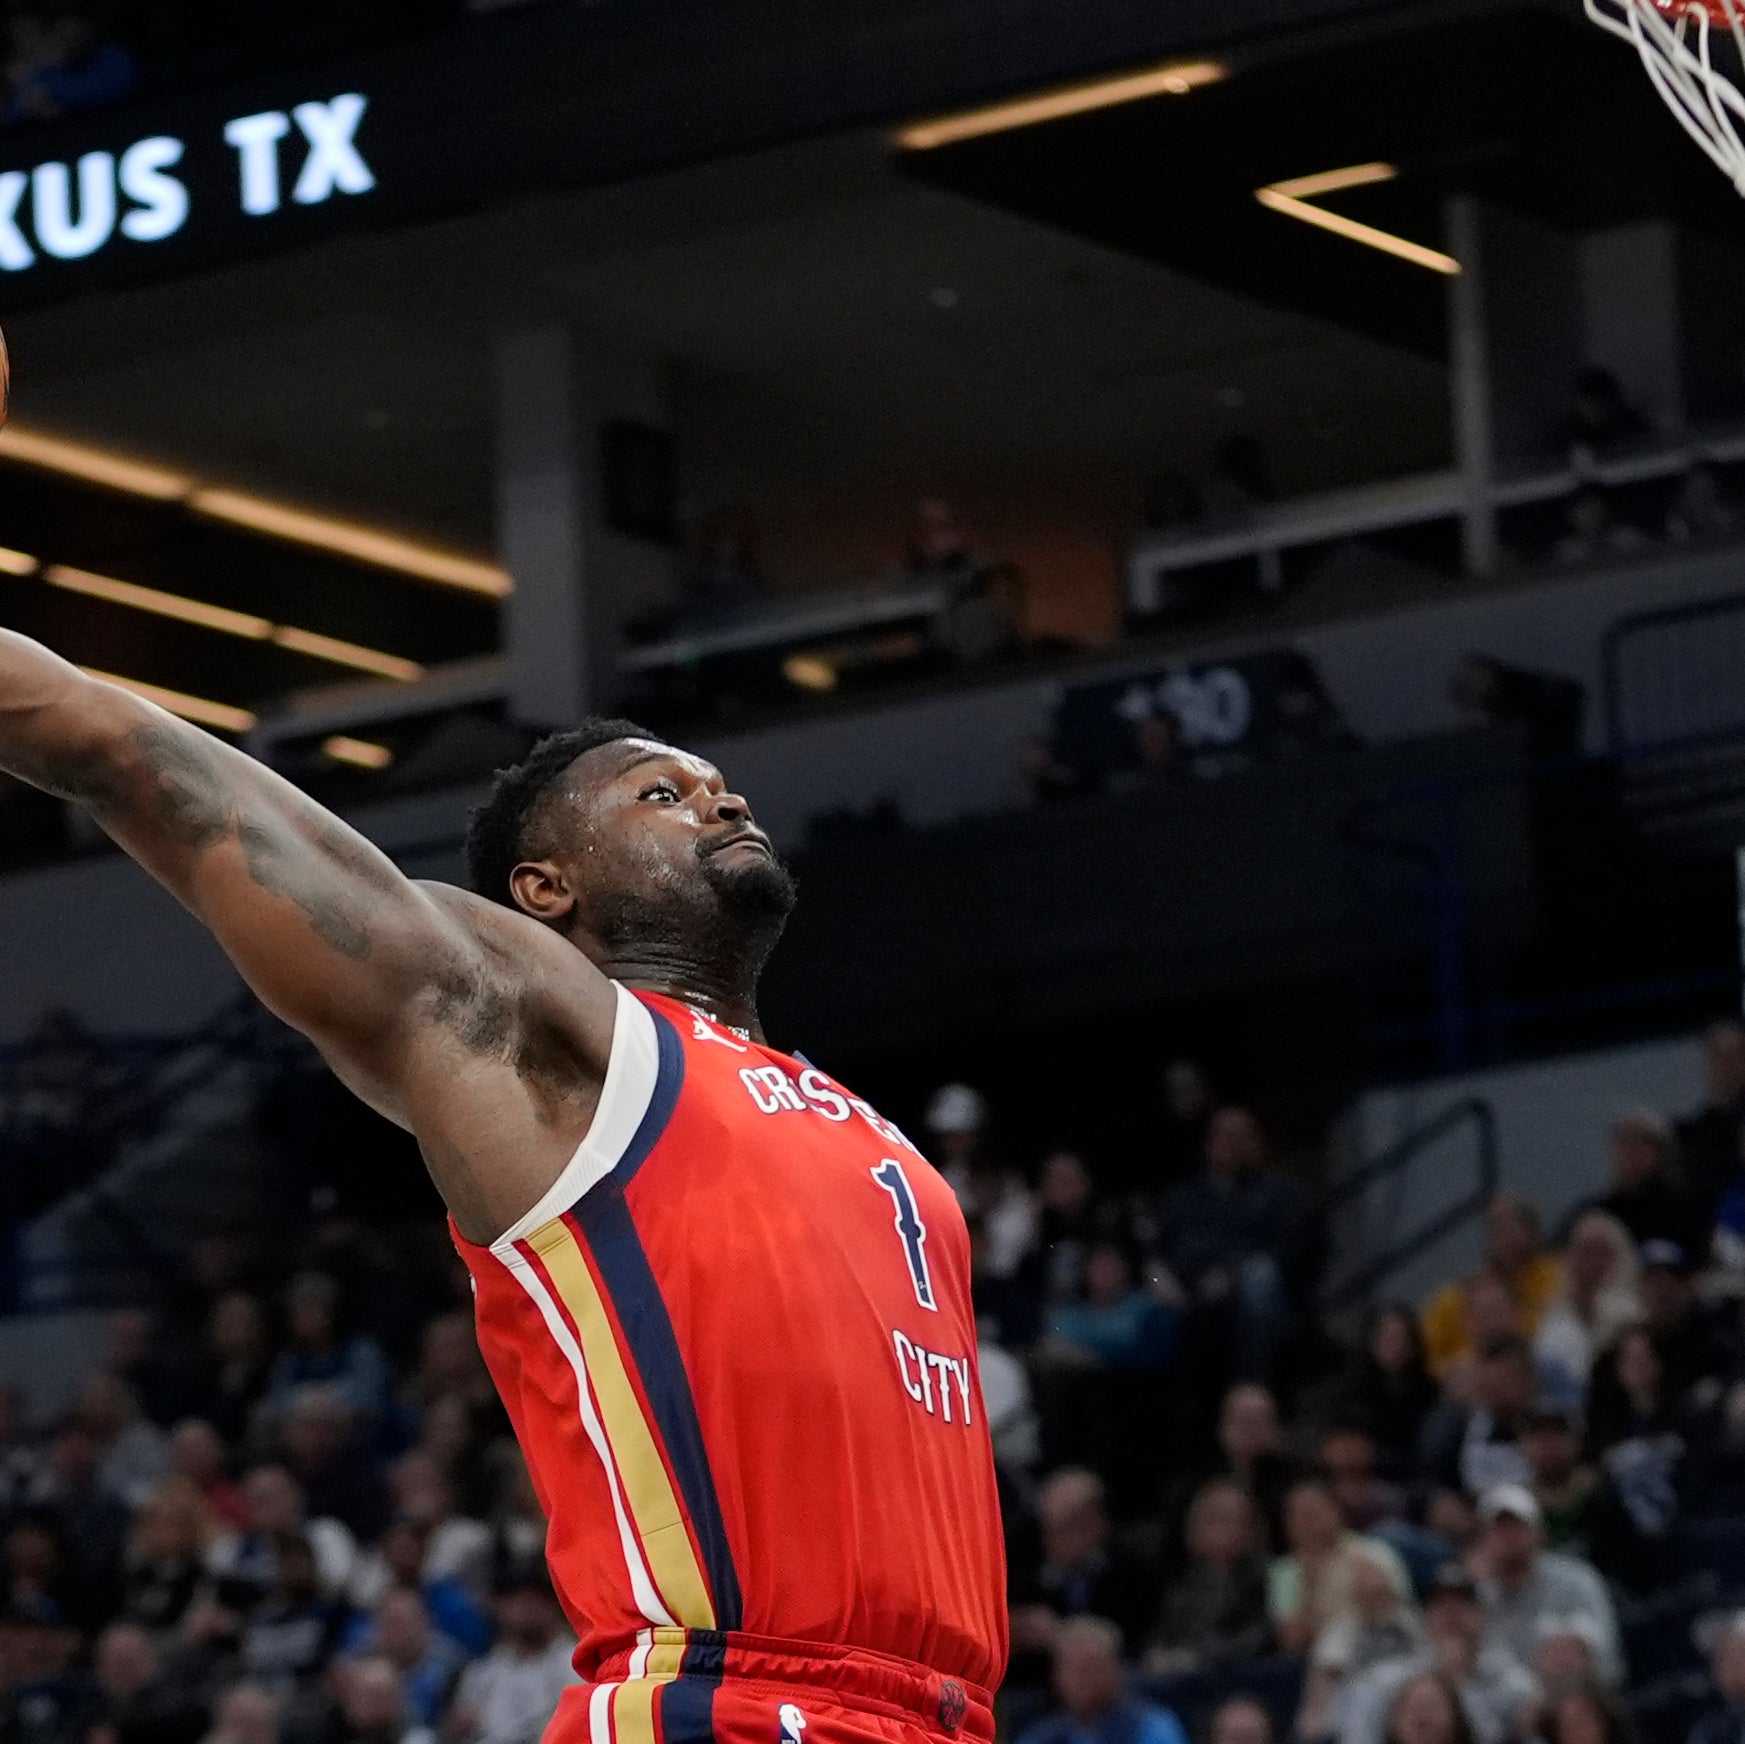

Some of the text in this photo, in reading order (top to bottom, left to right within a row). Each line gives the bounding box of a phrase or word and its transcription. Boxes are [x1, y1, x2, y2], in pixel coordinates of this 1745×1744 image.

[222, 91, 379, 217] TX
[870, 1158, 938, 1312] 1
[892, 1328, 971, 1426] CITY
